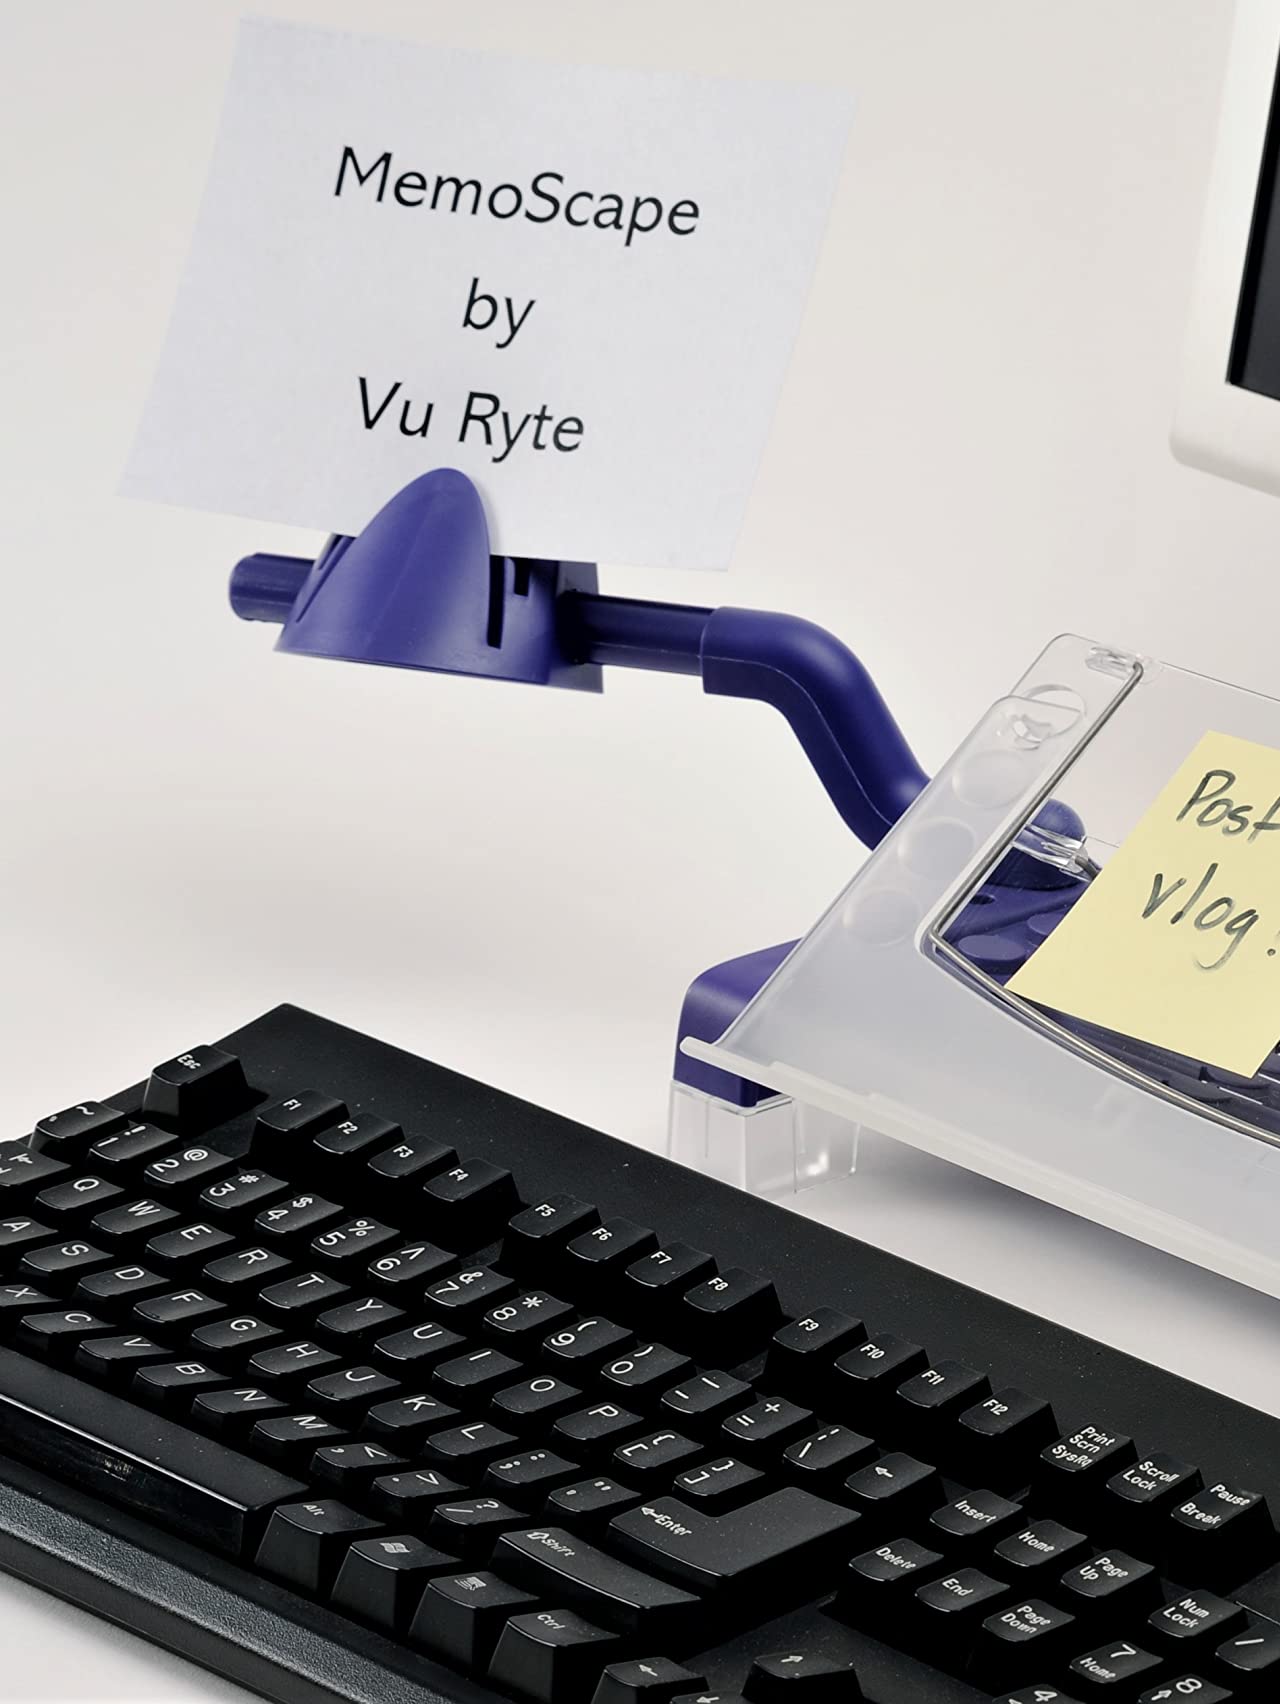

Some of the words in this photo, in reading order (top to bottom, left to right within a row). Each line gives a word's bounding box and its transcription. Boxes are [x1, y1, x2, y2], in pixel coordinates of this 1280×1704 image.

[334, 145, 700, 247] MemoScape
[462, 276, 536, 350] by
[358, 376, 434, 438] Vu
[457, 391, 584, 464] Ryte
[177, 1054, 201, 1069] Esc
[282, 1098, 302, 1111] F1
[337, 1121, 358, 1135] F2
[97, 1137, 119, 1147] 1
[392, 1145, 414, 1158] F3
[152, 1158, 180, 1173] 2
[448, 1168, 469, 1182] F4
[73, 1178, 100, 1192] Q
[209, 1182, 236, 1197] 3
[127, 1200, 161, 1217] W
[267, 1209, 289, 1221] 4
[534, 1203, 556, 1217] F5
[2, 1221, 32, 1233] A
[180, 1224, 213, 1241] E
[591, 1227, 613, 1241] F6
[319, 1231, 347, 1246] 5
[60, 1244, 90, 1257] S
[238, 1248, 269, 1265] R
[650, 1250, 673, 1265] F7
[376, 1257, 401, 1271] 6
[114, 1267, 145, 1280] D
[296, 1273, 325, 1287] T
[435, 1280, 460, 1295] 7
[707, 1277, 729, 1291] F8
[4, 1287, 38, 1298] X
[172, 1291, 203, 1304] F
[356, 1299, 383, 1312] Y
[64, 1313, 92, 1324] C
[492, 1306, 518, 1321] 8
[230, 1318, 258, 1331] G
[412, 1324, 443, 1340] U
[798, 1318, 820, 1332] F9
[123, 1337, 151, 1347] V
[550, 1332, 576, 1347] 9
[286, 1343, 319, 1359] H
[860, 1343, 885, 1359] F10
[174, 1363, 206, 1375] B
[610, 1360, 634, 1375] 0
[345, 1370, 376, 1382] J
[921, 1369, 945, 1386] F11
[530, 1378, 556, 1392] O
[233, 1389, 267, 1402] N
[404, 1396, 437, 1412] K
[587, 1405, 619, 1418] P
[982, 1398, 1009, 1416] F12
[292, 1415, 329, 1430] M
[460, 1424, 485, 1440] L
[1080, 1426, 1116, 1447] Print
[1069, 1434, 1101, 1454] Scrn
[1051, 1444, 1094, 1468] SysRq
[1138, 1460, 1180, 1483] Scroll
[1122, 1469, 1157, 1491] Lock
[1209, 1484, 1251, 1506] Pause
[302, 1504, 325, 1516] Alt
[954, 1500, 997, 1523] Insert
[1180, 1502, 1222, 1525] Break
[655, 1514, 692, 1538] Enter
[542, 1537, 575, 1557] Shift
[1018, 1531, 1055, 1553] Home
[875, 1546, 917, 1569] Delete
[1079, 1565, 1099, 1580] Up
[1094, 1557, 1129, 1578] Page
[941, 1578, 974, 1597] End
[1016, 1605, 1052, 1626] Page
[1179, 1598, 1210, 1619] Num
[537, 1614, 566, 1630] Ctrl
[1000, 1612, 1038, 1634] Down
[1163, 1606, 1199, 1629] Lock
[1110, 1643, 1137, 1658] 7
[1079, 1657, 1117, 1679] Home
[1175, 1678, 1203, 1694] 8
[1033, 1690, 1058, 1702] 4
